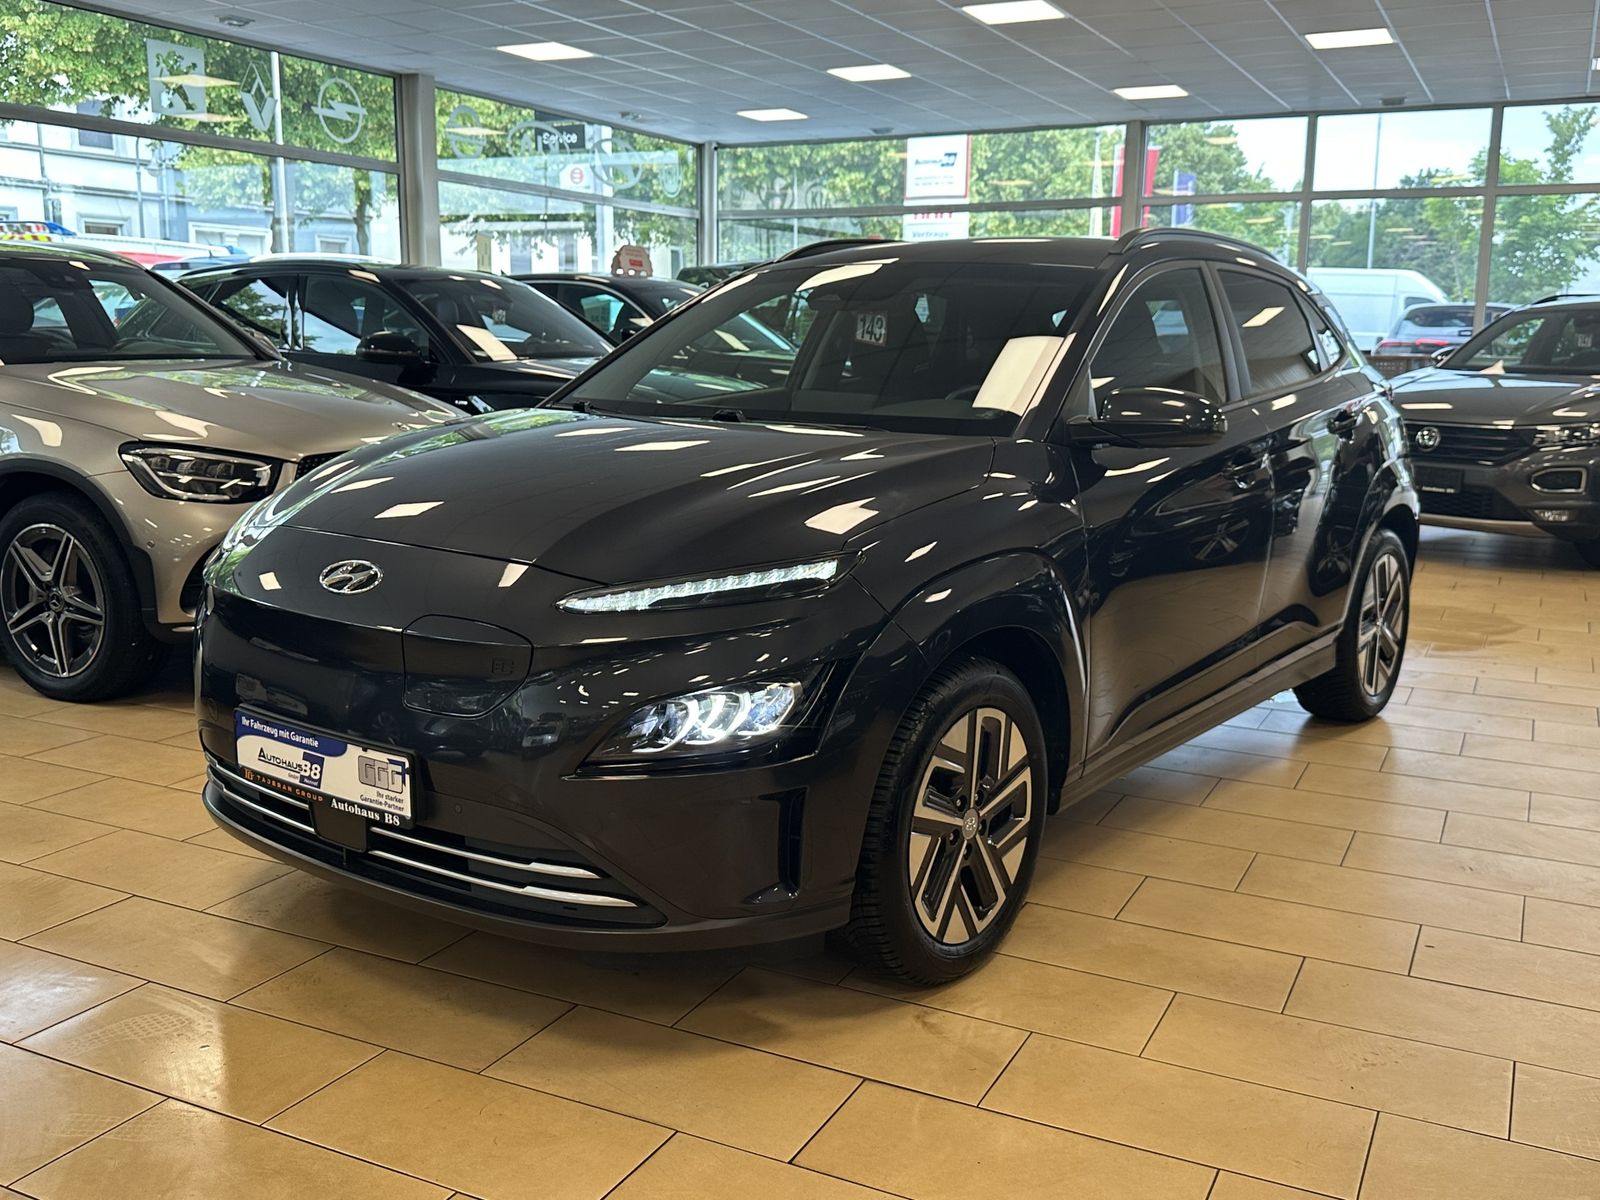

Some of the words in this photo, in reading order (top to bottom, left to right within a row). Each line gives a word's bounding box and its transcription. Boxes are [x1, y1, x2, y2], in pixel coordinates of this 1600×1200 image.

[859, 315, 884, 342] 143
[241, 716, 250, 727] Ihr
[250, 719, 278, 738] Fahrzeug
[279, 728, 290, 740] mit
[290, 731, 319, 748] Garantie
[360, 794, 405, 812] Garantie-Partner
[376, 791, 384, 799] Ihr
[385, 794, 404, 804] starker
[331, 798, 380, 821] Autohaus
[384, 813, 400, 827] B8
